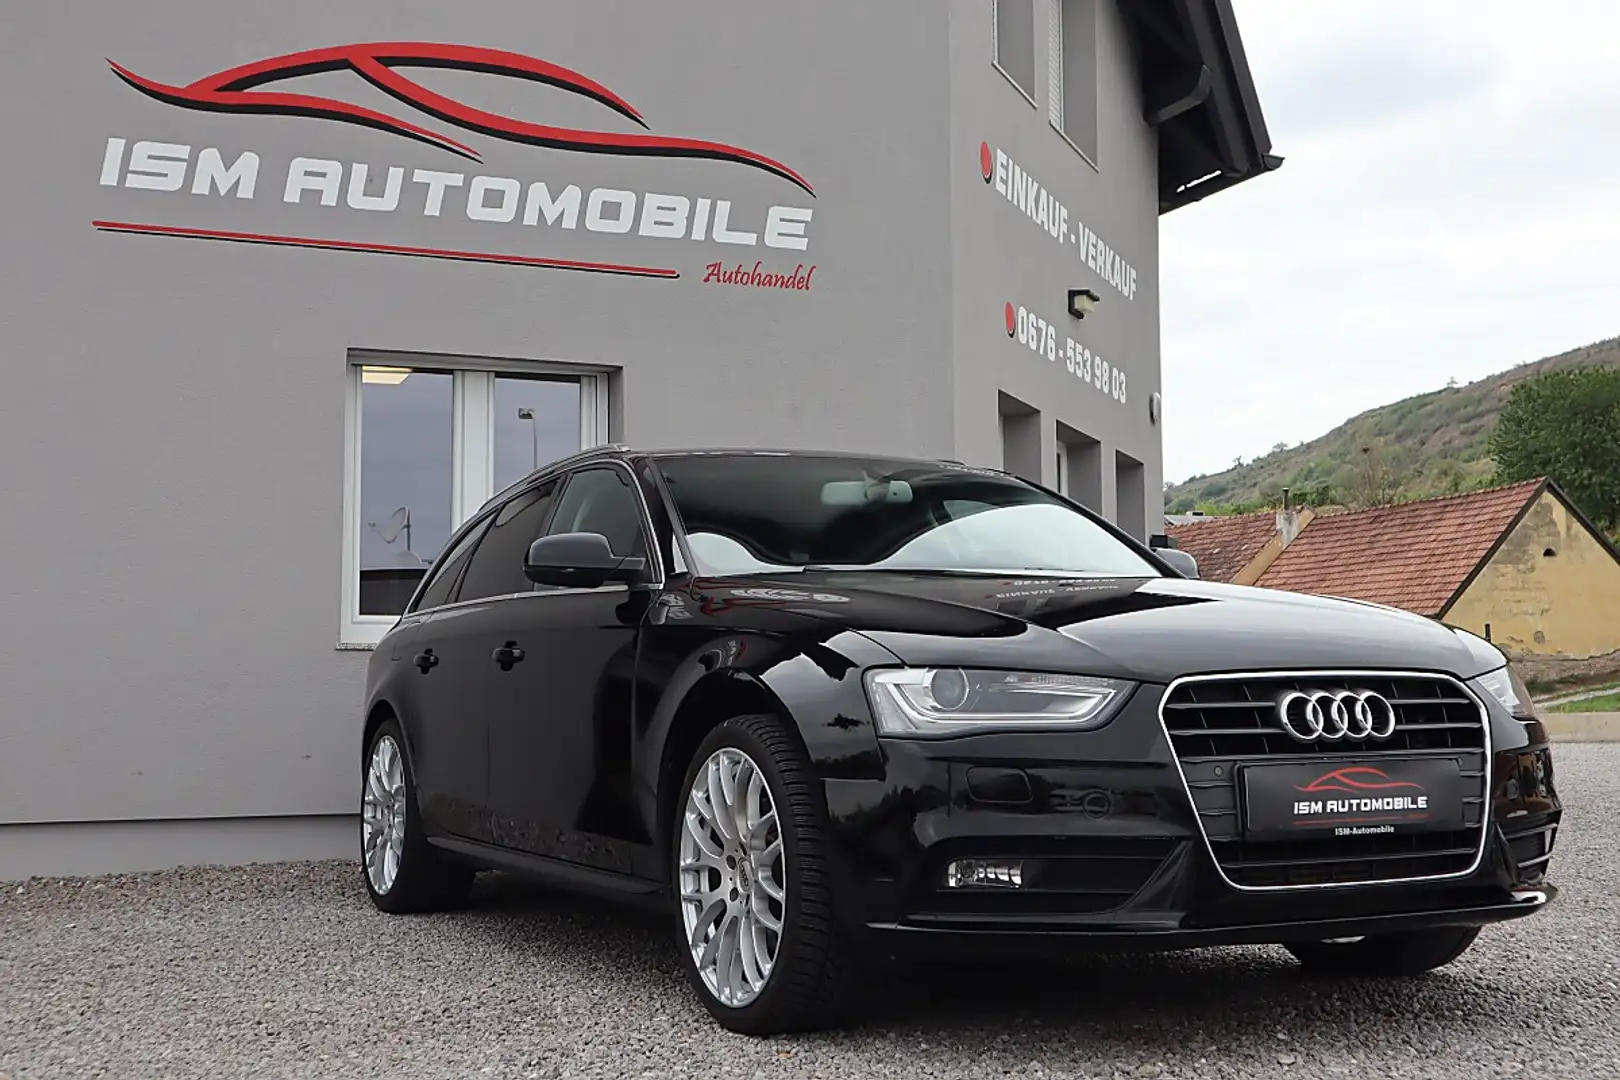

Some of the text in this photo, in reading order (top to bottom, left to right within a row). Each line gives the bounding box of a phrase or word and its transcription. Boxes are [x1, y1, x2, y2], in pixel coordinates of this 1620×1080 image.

[101, 138, 814, 251] ISM AUTOMOBILE
[995, 148, 1068, 244] EINKAUF
[1078, 221, 1137, 300] VERKAUF
[703, 260, 816, 291] Autohandel
[1017, 306, 1057, 362] 0676
[1066, 337, 1091, 383] 553
[1094, 355, 1110, 394] 98
[1112, 367, 1127, 404] 03
[1294, 796, 1428, 815] ISM AUTOMOBILE
[1335, 825, 1395, 836] ISM-Automobile
